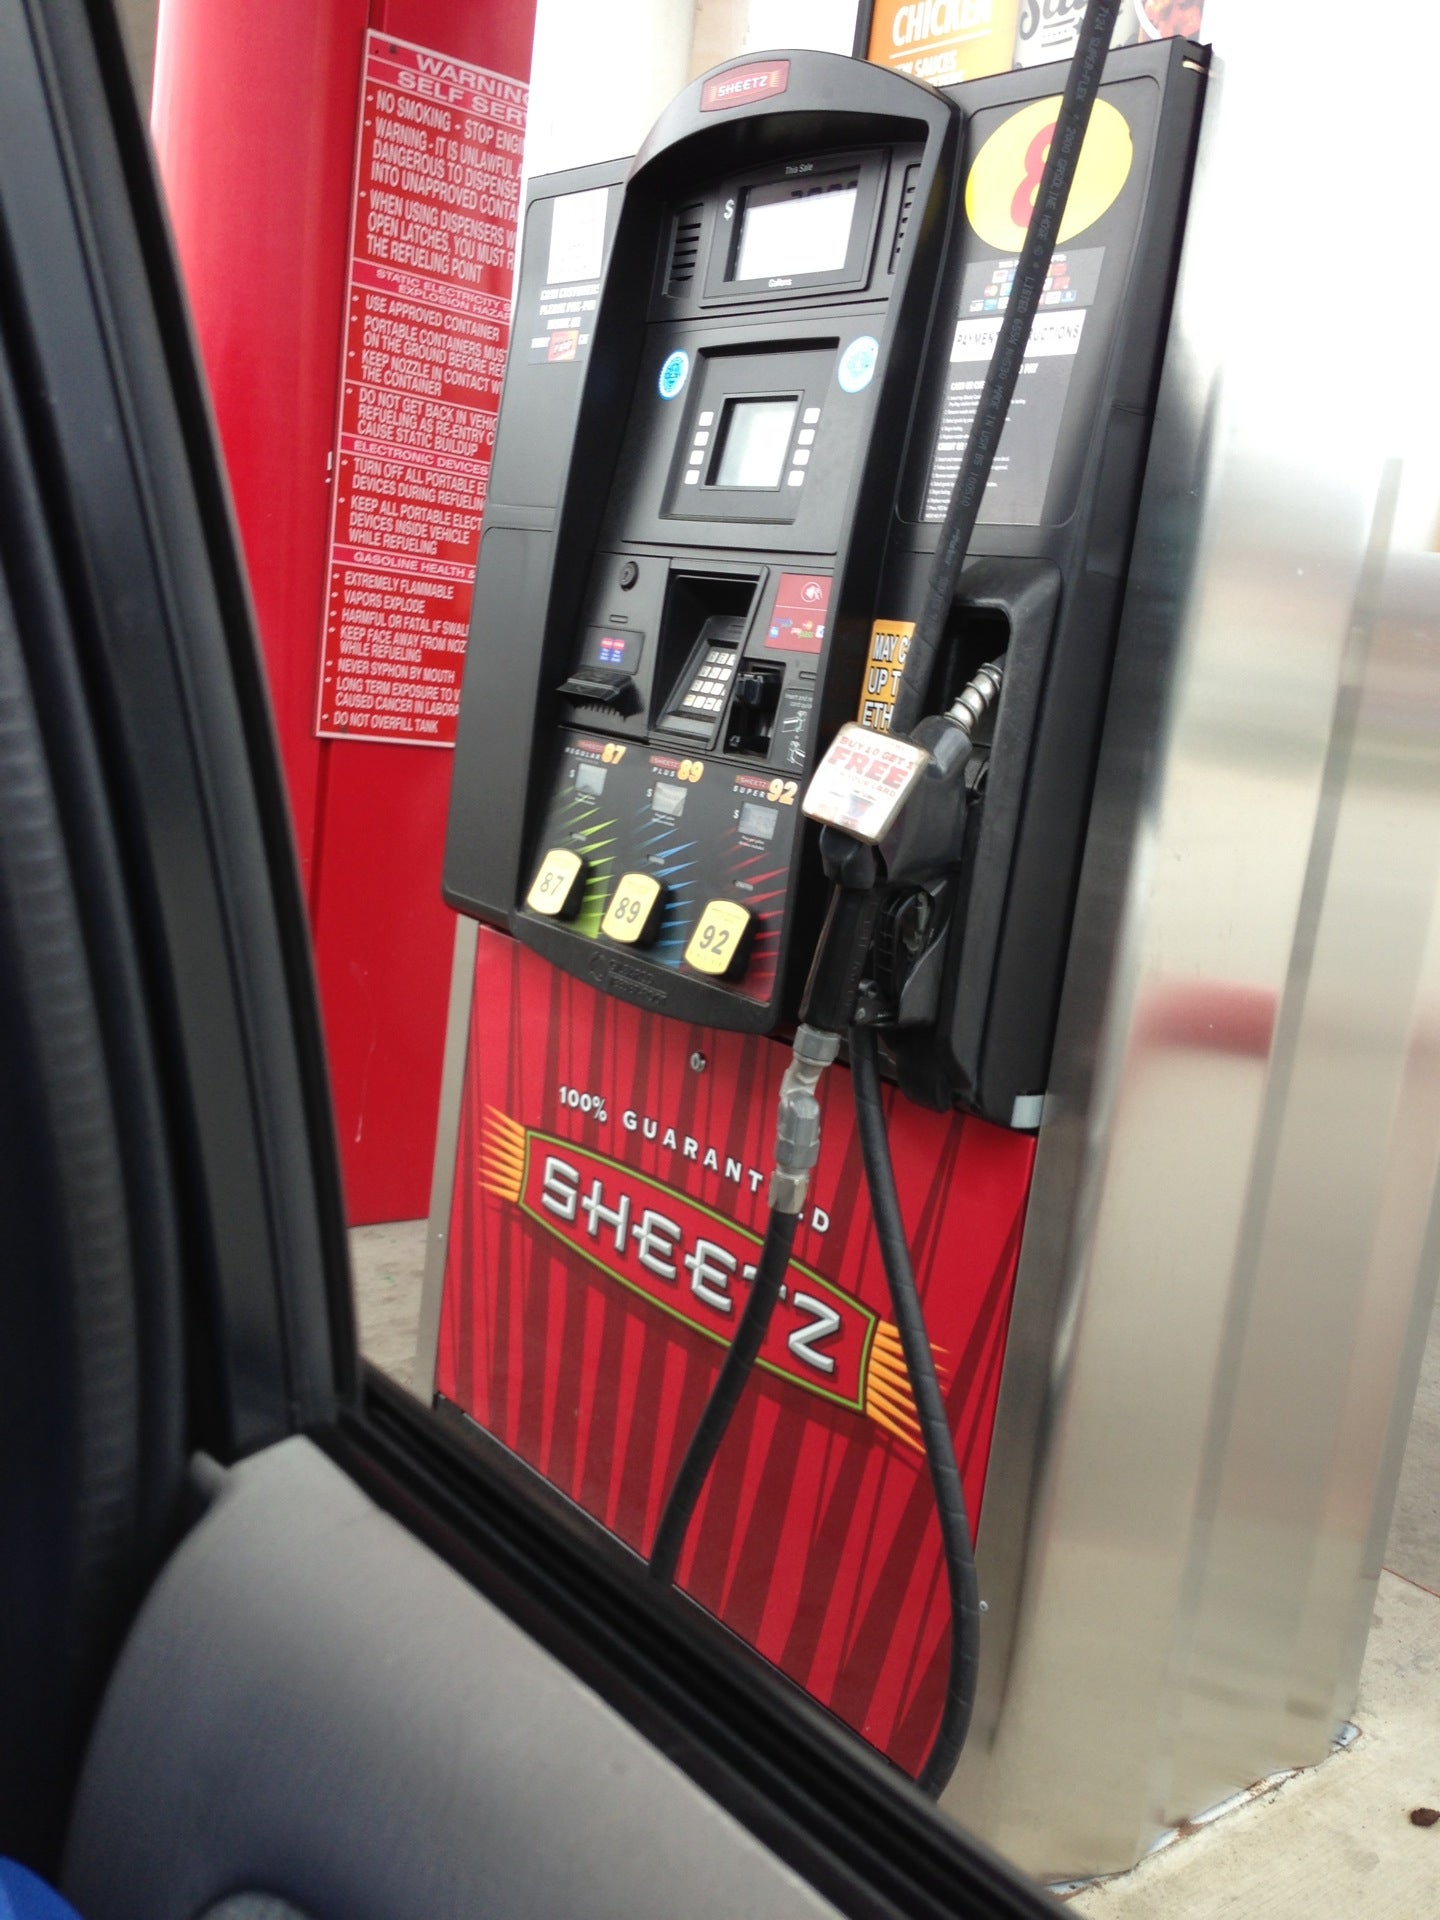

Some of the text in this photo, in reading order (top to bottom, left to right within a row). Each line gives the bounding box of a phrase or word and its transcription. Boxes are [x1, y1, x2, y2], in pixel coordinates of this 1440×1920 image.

[397, 69, 527, 128] SELF SER
[718, 75, 769, 97] SHEETZ
[376, 89, 494, 145] NO SMOKING STOP
[375, 116, 514, 179] WARNING IT IS UNLAWFUL
[370, 160, 478, 210] INTO UNAPPROVED
[372, 138, 518, 201] DANGEROUS TO DISPENSE
[369, 189, 504, 246] WHEN USING DISPENSERS
[724, 199, 734, 221] $
[367, 210, 399, 238] OPEN
[452, 235, 475, 260] YOU
[476, 242, 506, 267] MUST
[366, 233, 483, 283] THE REFUELING POINT
[375, 268, 500, 309] STATIC ELECTRICITY
[398, 283, 469, 310] EXPLOSION
[365, 294, 500, 341] USE APPROVED CONTAINER
[363, 314, 418, 342] PORTABLE
[418, 328, 482, 357] CONTAINERS
[363, 331, 487, 373] ON THE GROUND BEFORE
[361, 349, 490, 392] KEEP NOZZLE IN CONTACT
[361, 364, 442, 396] THE CONTAINER
[358, 388, 375, 405] DO
[377, 392, 399, 410] NOT
[401, 397, 424, 415] GET
[426, 402, 454, 422] BACK
[455, 409, 467, 424] IN
[356, 419, 478, 456] CAUSE STATIC BUILDUP
[358, 404, 485, 443] REFUELING AS RE-ENTRY
[353, 440, 489, 475] ELECTRONIC DEVICES
[352, 474, 396, 495] DEVICES
[397, 482, 436, 502] DURING
[353, 457, 475, 493] TURN OFF ALL PORTABLE
[350, 495, 378, 513] KEEP
[379, 500, 399, 517] ALL
[399, 504, 451, 525] PORTABLE
[348, 528, 437, 555] WHILE REFUELING
[349, 512, 470, 544] DEVICES INSIDE VEHICLE
[353, 552, 418, 570] GASOLINE
[420, 562, 465, 577] HEALTH
[344, 570, 454, 599] EXTREMELY FLAMMABLE
[343, 589, 425, 613] VAPORS EXPLODE
[341, 607, 442, 633] HARMFUL OR FATAL IF
[339, 625, 366, 641] KEEP
[366, 628, 392, 644] FACE
[392, 631, 419, 647] AWAY
[420, 635, 446, 650] FROM
[339, 640, 422, 662] WHILE REFUELING
[872, 633, 900, 662] MAY
[337, 658, 455, 683] NEVER SYPHON BY MOUTH
[868, 666, 888, 695] UP
[335, 692, 374, 709] CAUSED
[375, 696, 413, 712] CANCER
[414, 700, 424, 713] IN
[336, 676, 452, 701] LONG TERM EXPOSURE TO
[333, 711, 438, 733] DO NOT OVERFILL TANK
[862, 699, 895, 730] ETH
[564, 747, 601, 760] REGULAR
[601, 743, 627, 765] 87
[828, 746, 909, 789] FREE
[839, 736, 914, 770] BUY 10 GET 1
[652, 759, 705, 783] PLUS 89
[732, 778, 798, 806] SUPER 92
[540, 872, 565, 896] 87
[614, 897, 642, 924] 89
[700, 925, 730, 956] 92
[559, 1086, 830, 1233] 100% GUARANTD
[541, 1155, 840, 1373] SHEEZ
